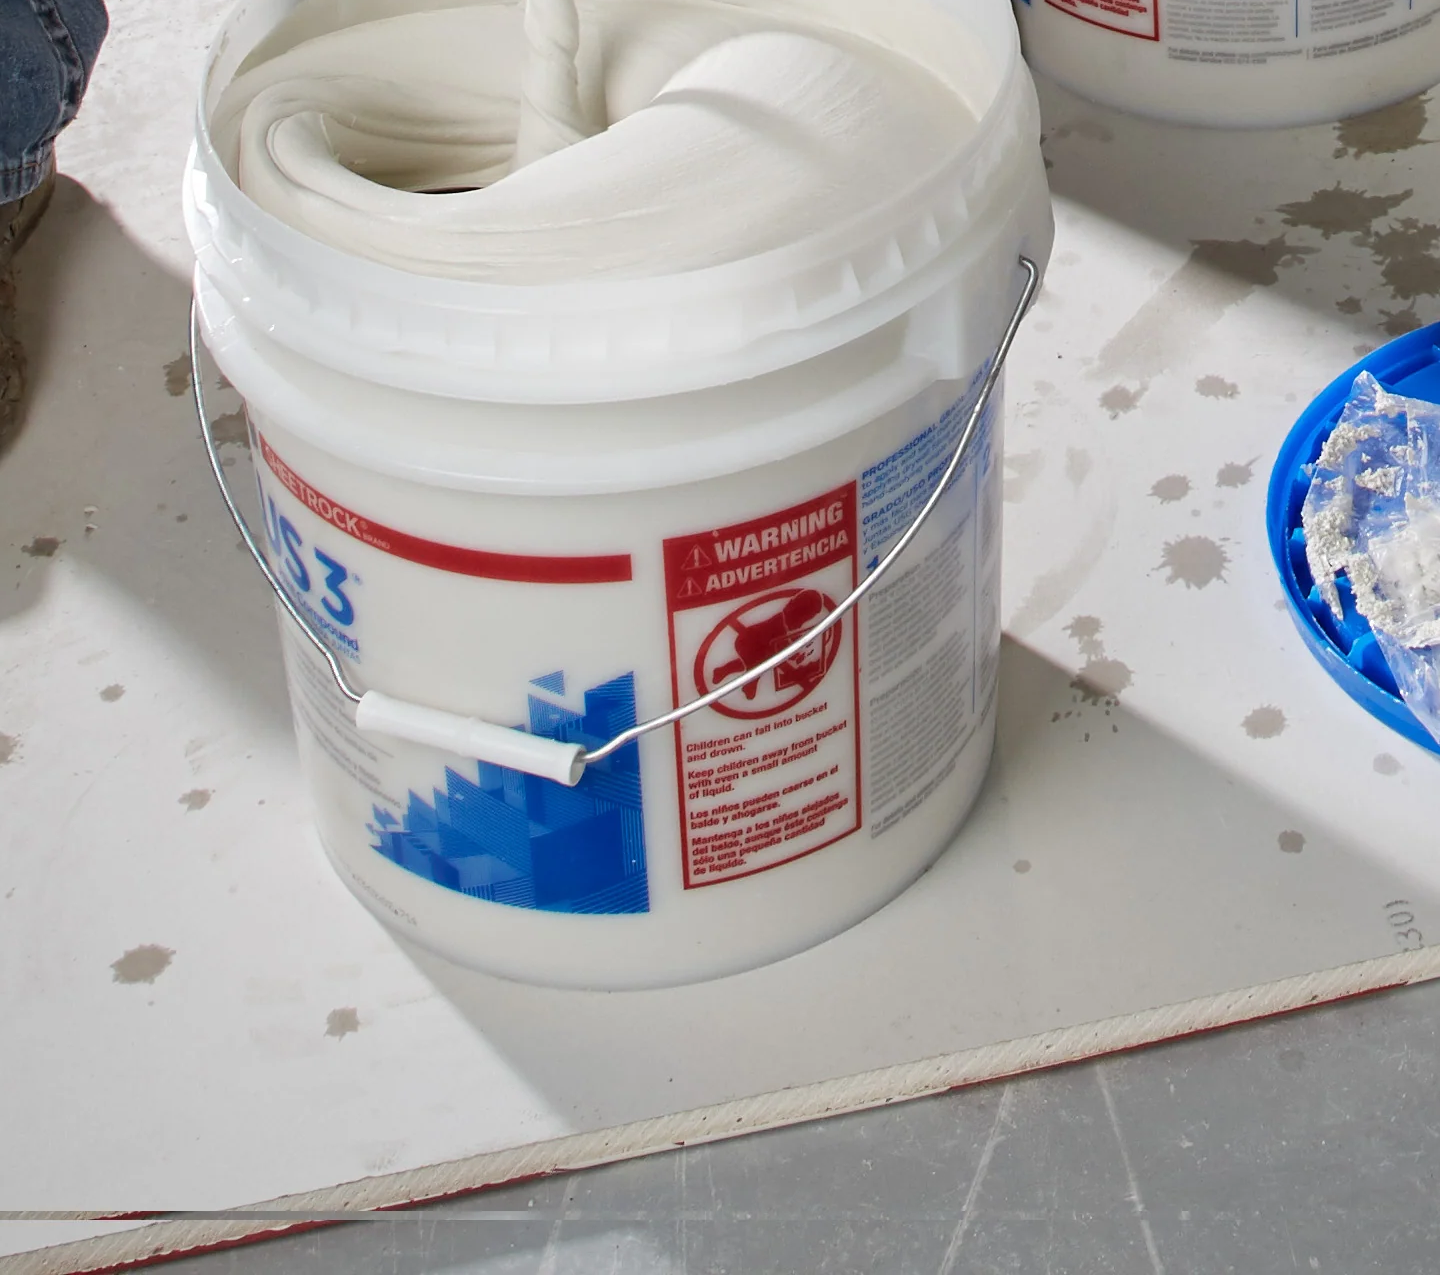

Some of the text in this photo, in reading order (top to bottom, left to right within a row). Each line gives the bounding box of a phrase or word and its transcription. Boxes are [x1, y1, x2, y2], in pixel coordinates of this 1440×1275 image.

[861, 423, 937, 481] PROFESSIONAL
[714, 501, 844, 564] WARNING
[313, 546, 354, 626] 3
[704, 529, 849, 594] ADVERTENCIA
[686, 701, 828, 753] Children can fall into bucket
[687, 743, 746, 763] and drown.
[688, 719, 848, 780] Keep children away from bucket
[688, 778, 713, 791] with
[714, 772, 740, 785] even
[751, 759, 780, 776] small
[781, 743, 818, 766] amount
[688, 783, 735, 800] of liquid.
[690, 764, 839, 821] Los niños pueden caerse en el
[691, 817, 720, 830] balde
[731, 801, 781, 821] ahogarse.
[691, 792, 840, 847] Mantenga los niños alejados
[692, 845, 709, 857] del
[744, 826, 782, 844] aunque
[693, 817, 826, 867] sólo una pequeña cantidad
[693, 867, 707, 876] de
